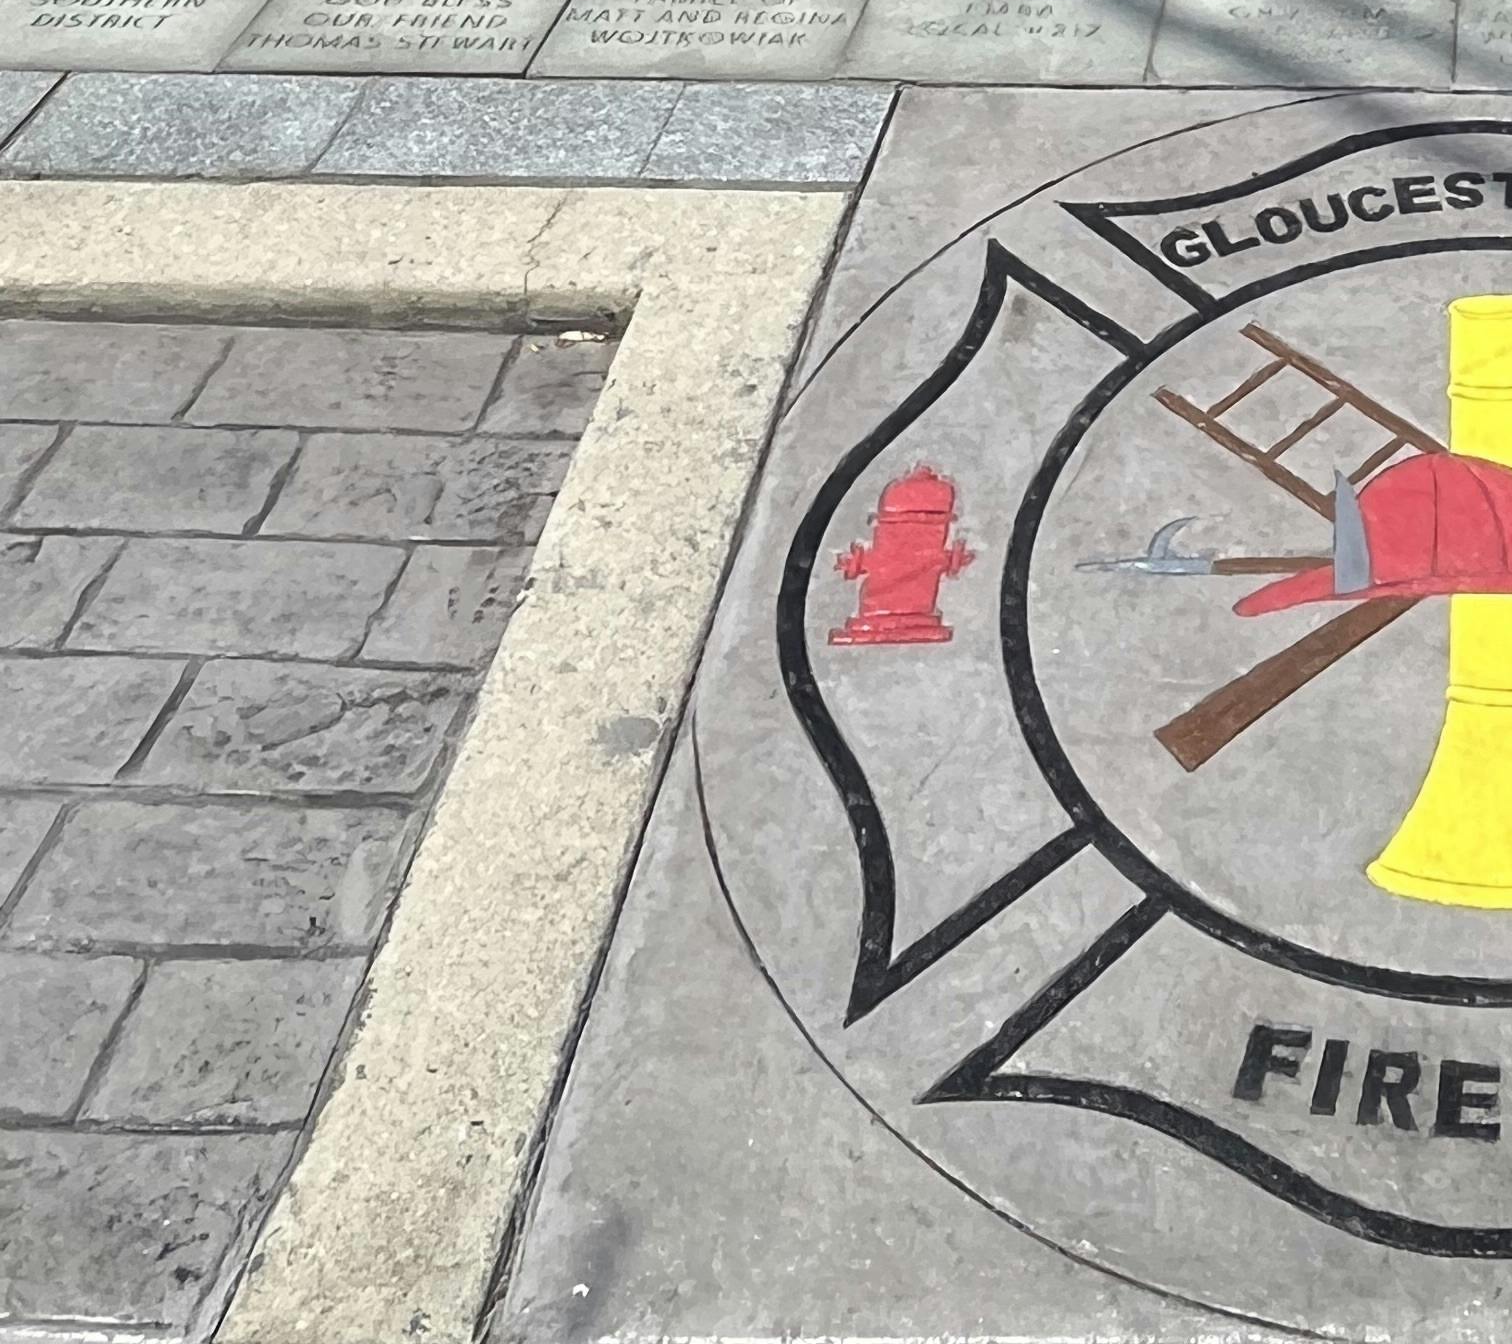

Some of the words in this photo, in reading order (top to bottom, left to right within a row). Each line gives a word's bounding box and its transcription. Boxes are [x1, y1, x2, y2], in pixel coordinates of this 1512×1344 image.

[30, 12, 173, 30] DISTRICT
[303, 12, 374, 29] OUR
[392, 13, 508, 30] FRIEND
[564, 7, 648, 24] MATT
[654, 8, 722, 25] AND
[246, 32, 382, 51] THOMAS
[397, 35, 536, 52] STEWART
[1230, 1023, 1505, 1142] FIRE
